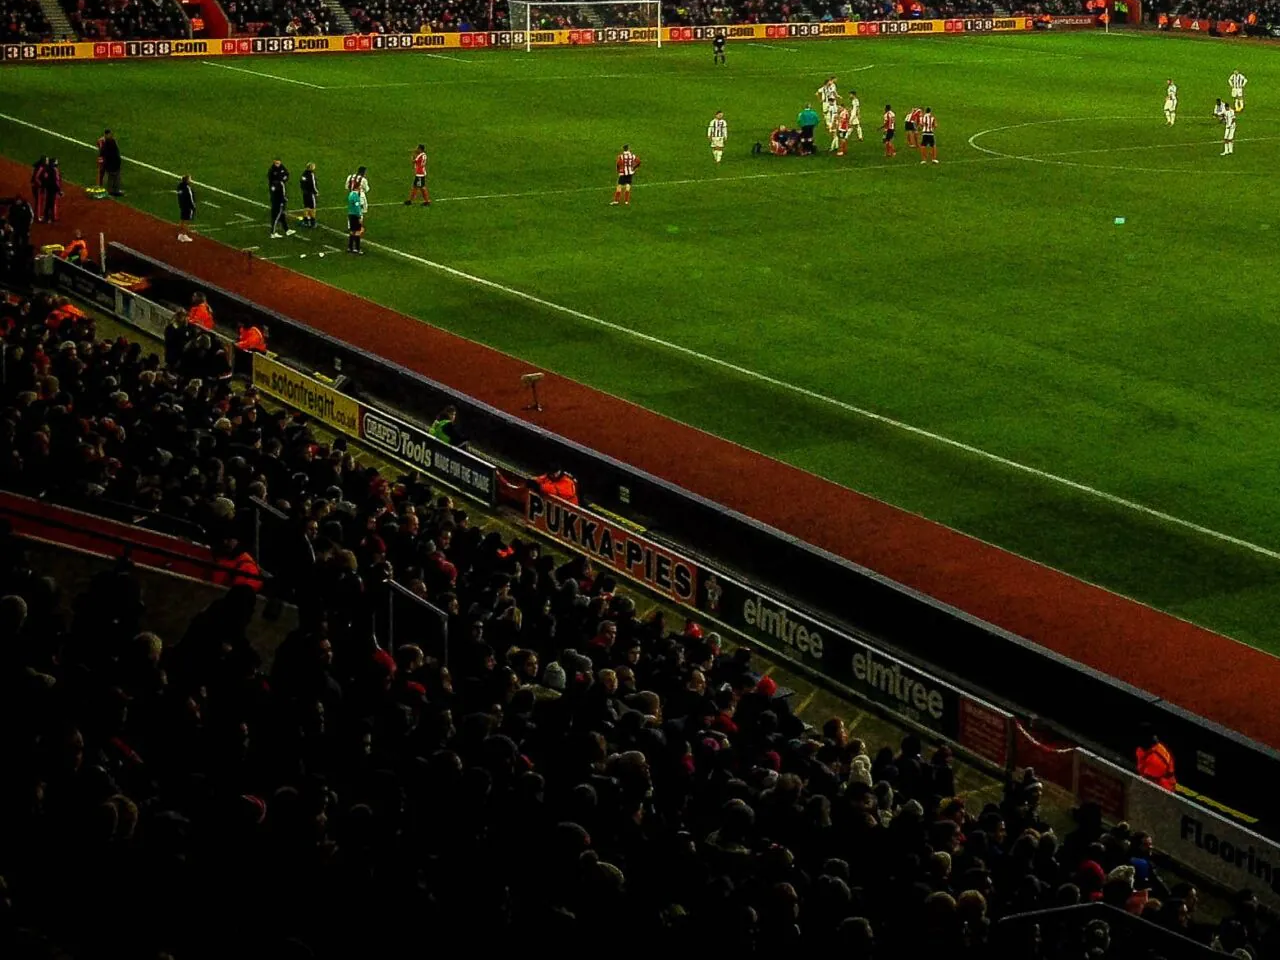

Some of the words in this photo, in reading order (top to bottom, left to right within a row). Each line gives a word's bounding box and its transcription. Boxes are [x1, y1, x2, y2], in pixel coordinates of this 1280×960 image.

[400, 431, 432, 468] Tools
[528, 491, 696, 601] PUKKA-PIES
[743, 595, 824, 659] elmtree
[851, 650, 945, 720] elmtree
